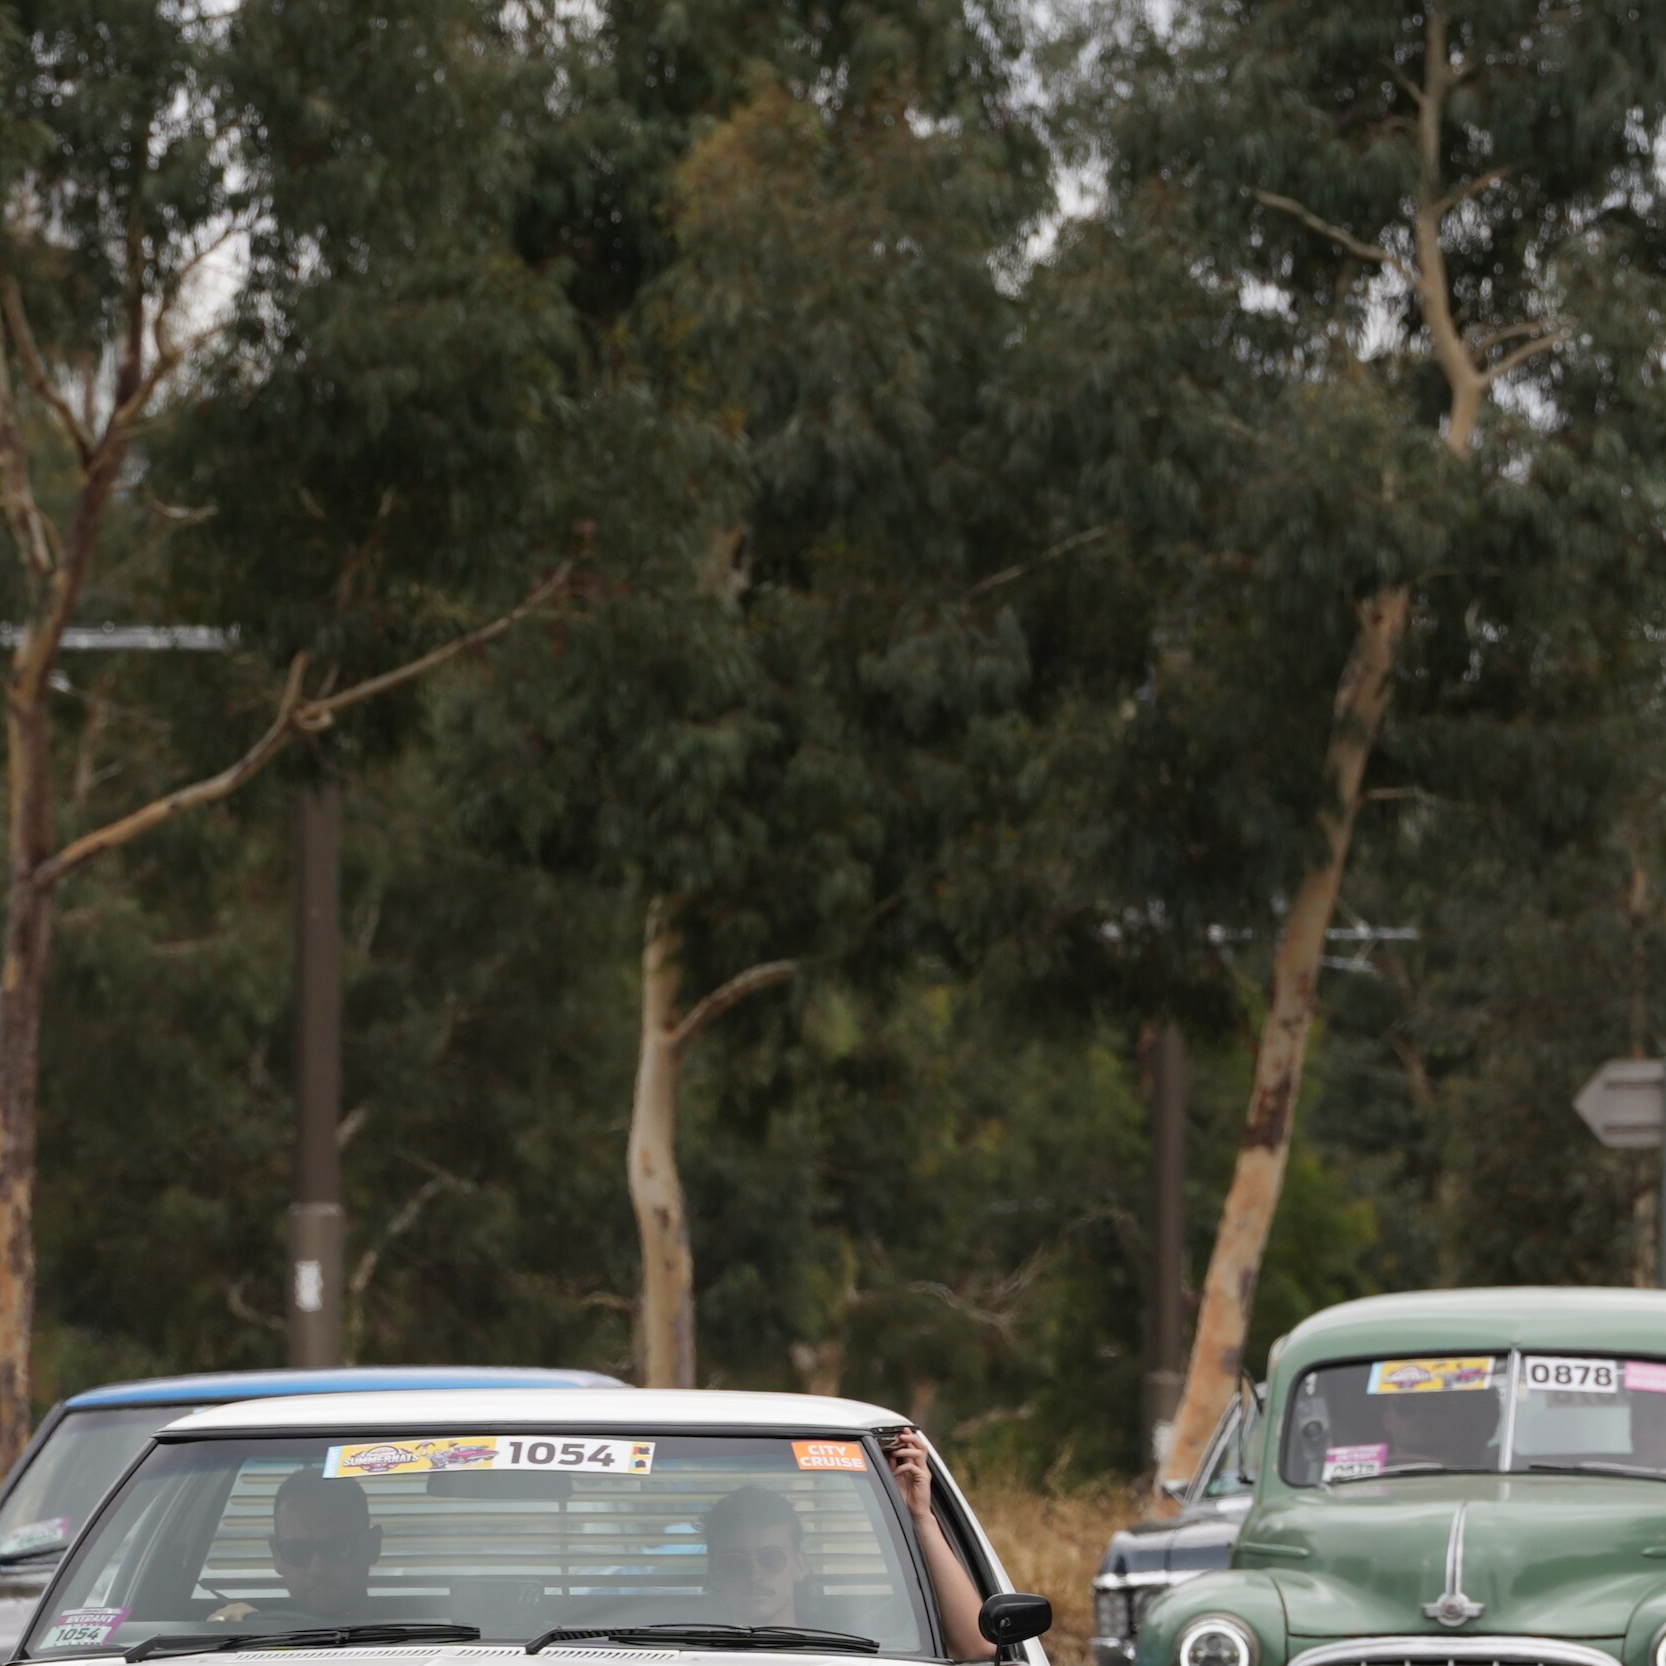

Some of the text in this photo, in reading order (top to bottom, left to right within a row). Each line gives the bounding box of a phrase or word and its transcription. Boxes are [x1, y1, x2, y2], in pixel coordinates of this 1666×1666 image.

[1532, 1364, 1612, 1386] 0878
[509, 1441, 615, 1467] 1054
[807, 1445, 846, 1456] CITY
[800, 1456, 863, 1467] CRUISE
[56, 1628, 101, 1642] 1054
